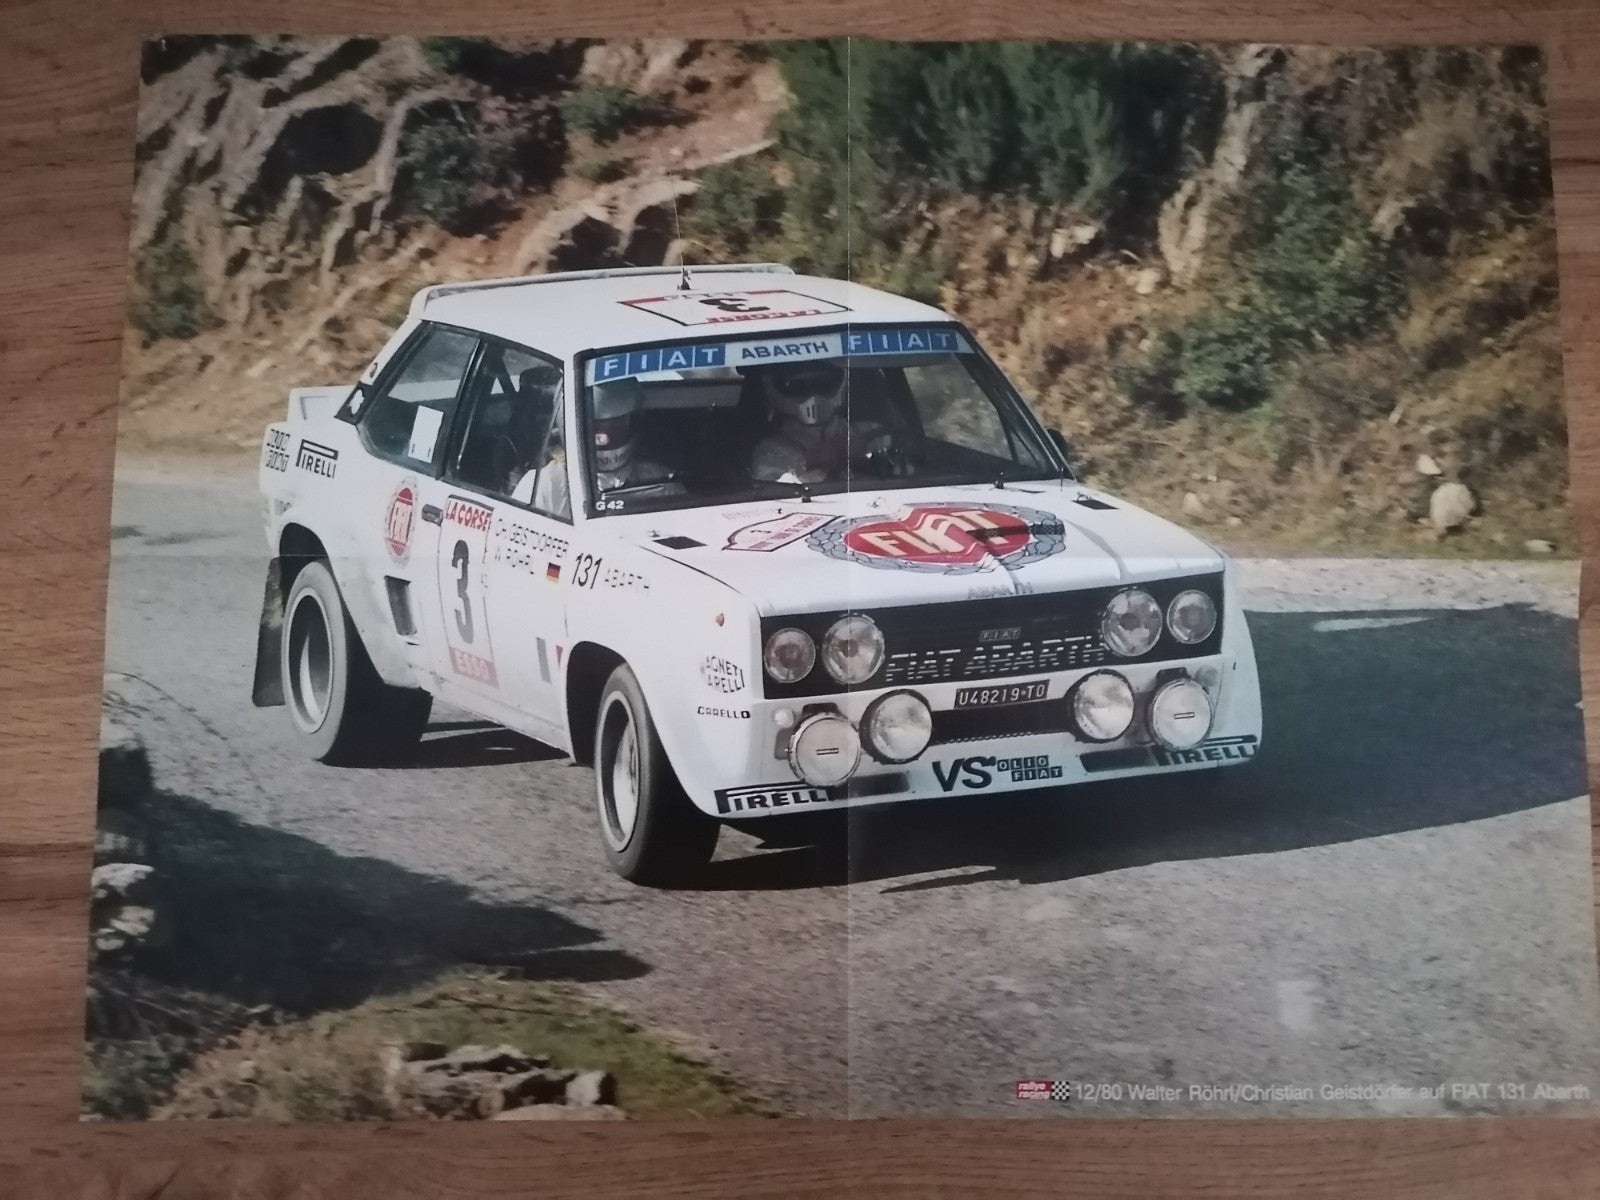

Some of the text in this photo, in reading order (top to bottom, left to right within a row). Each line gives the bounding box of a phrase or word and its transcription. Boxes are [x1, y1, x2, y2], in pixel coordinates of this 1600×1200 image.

[603, 333, 951, 377] FIAT ABARTH FIAT
[296, 439, 339, 479] PIRELLI
[859, 510, 1009, 557] FIAT
[572, 553, 603, 589] 131
[451, 539, 474, 644] 3
[983, 629, 1019, 641] FIAT
[886, 649, 961, 682] FIAT
[998, 756, 1048, 772] OLIO
[1012, 767, 1062, 781] FIAT
[1075, 1084, 1122, 1102] 12/80
[1128, 1084, 1183, 1100] Walter
[1420, 1083, 1446, 1100] auf
[1452, 1083, 1491, 1099] FIAT
[1498, 1083, 1526, 1099] 131
[1533, 1082, 1590, 1099] Abarth
